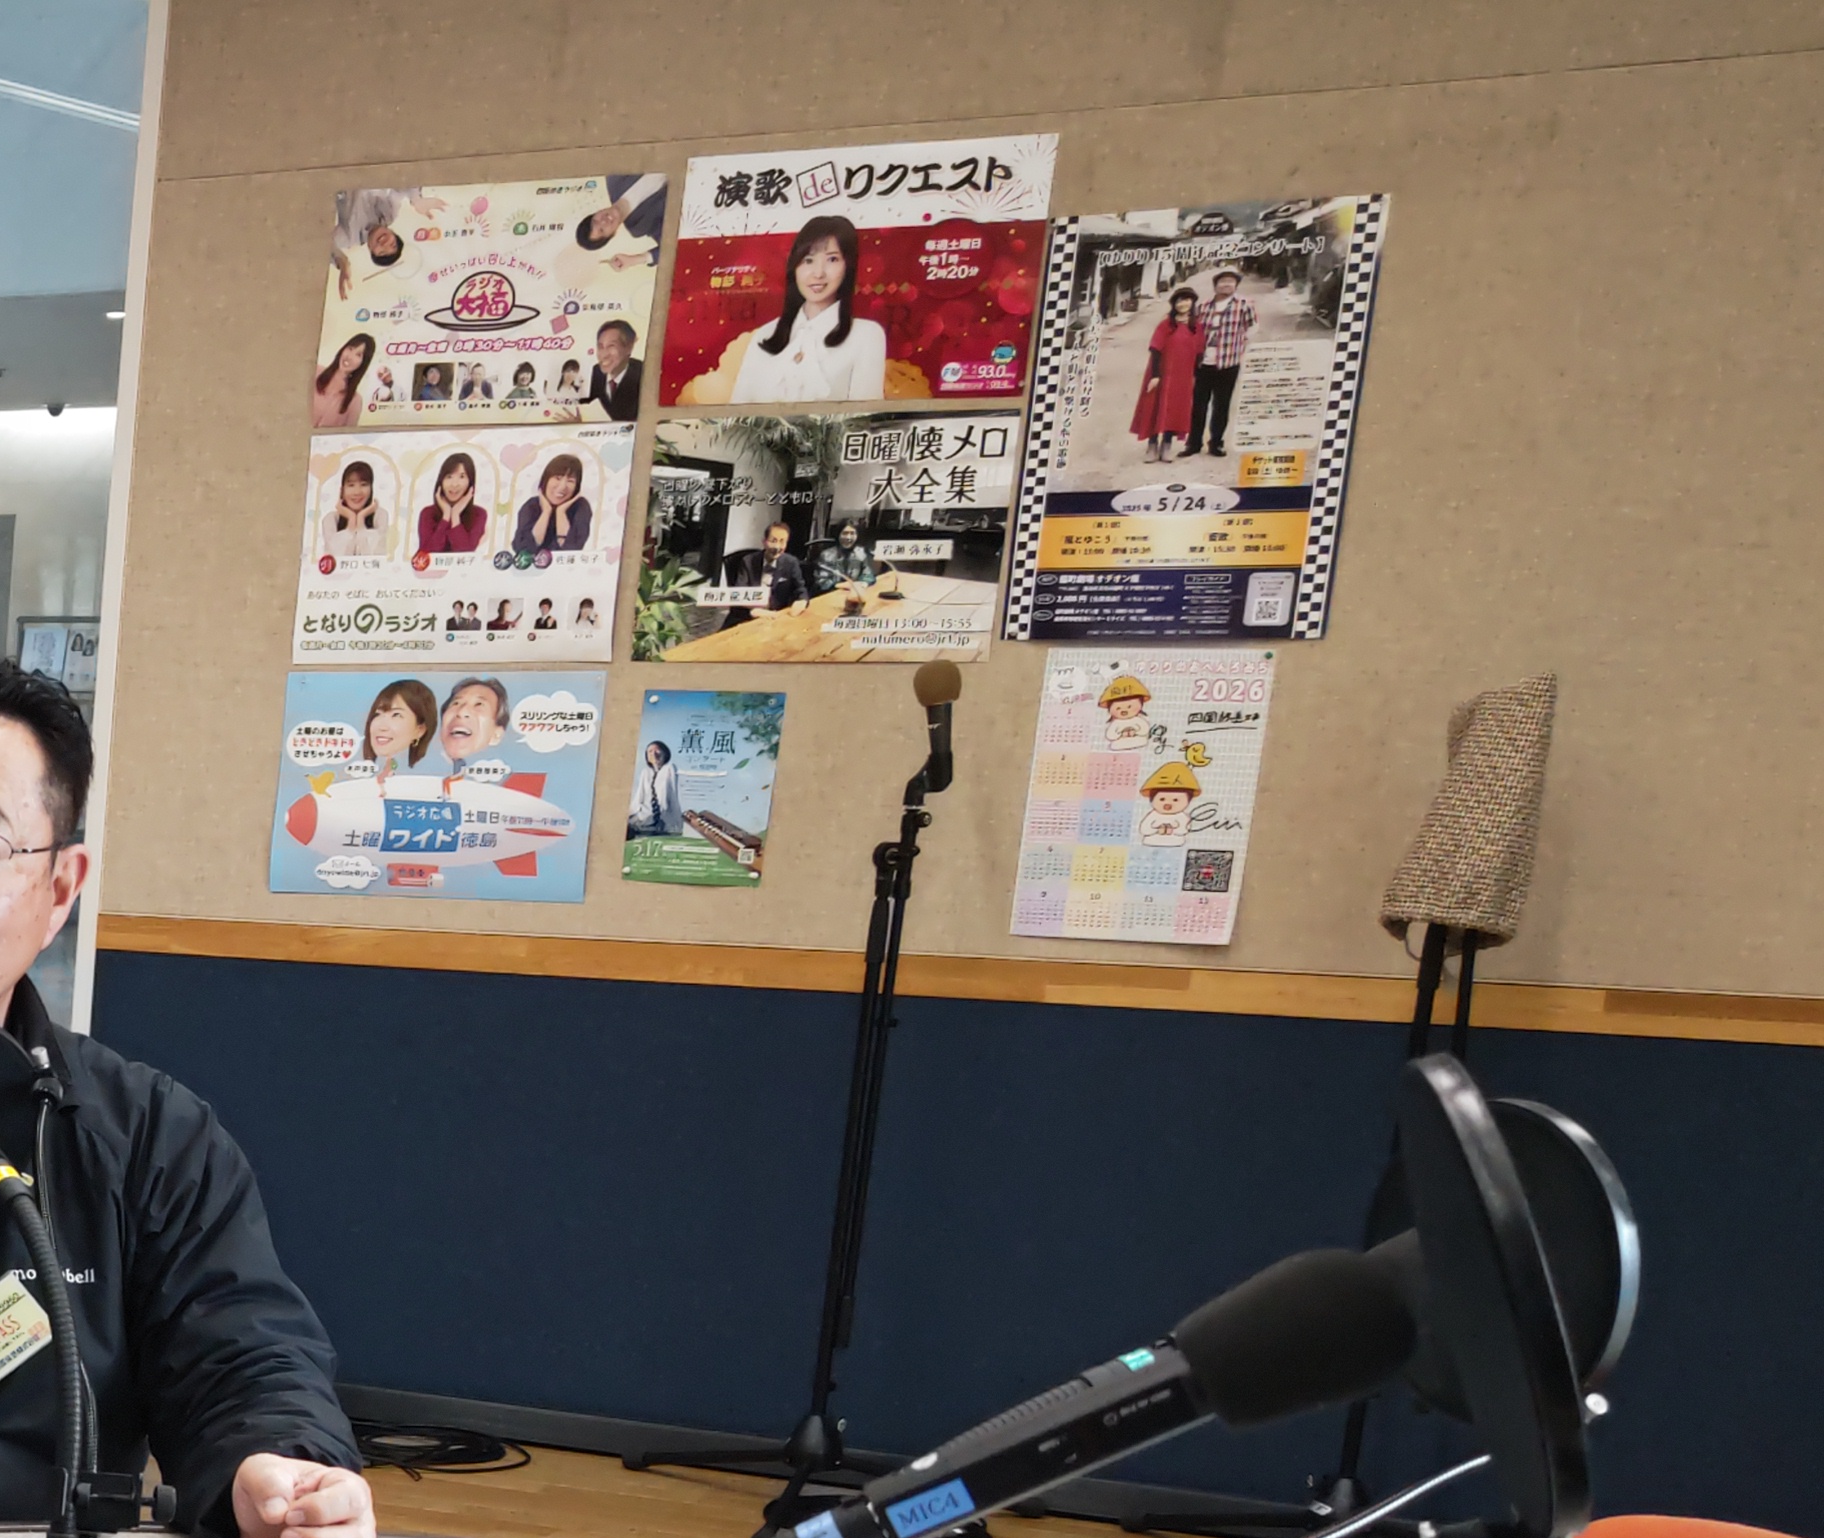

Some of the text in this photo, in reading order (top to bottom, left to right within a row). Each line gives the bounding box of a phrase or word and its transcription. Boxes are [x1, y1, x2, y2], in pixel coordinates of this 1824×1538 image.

[925, 238, 982, 252] 毎週土曜日
[455, 290, 509, 319] 大福
[842, 425, 1008, 463] 日曜懐メロ
[867, 466, 978, 505] 大全集
[303, 603, 437, 633] となりのラジオ
[1192, 679, 1265, 702] 2026
[519, 710, 594, 721] スリリングな土曜日
[678, 728, 735, 754] 薫風
[1158, 775, 1183, 785] 二人
[633, 840, 662, 857] 5.17
